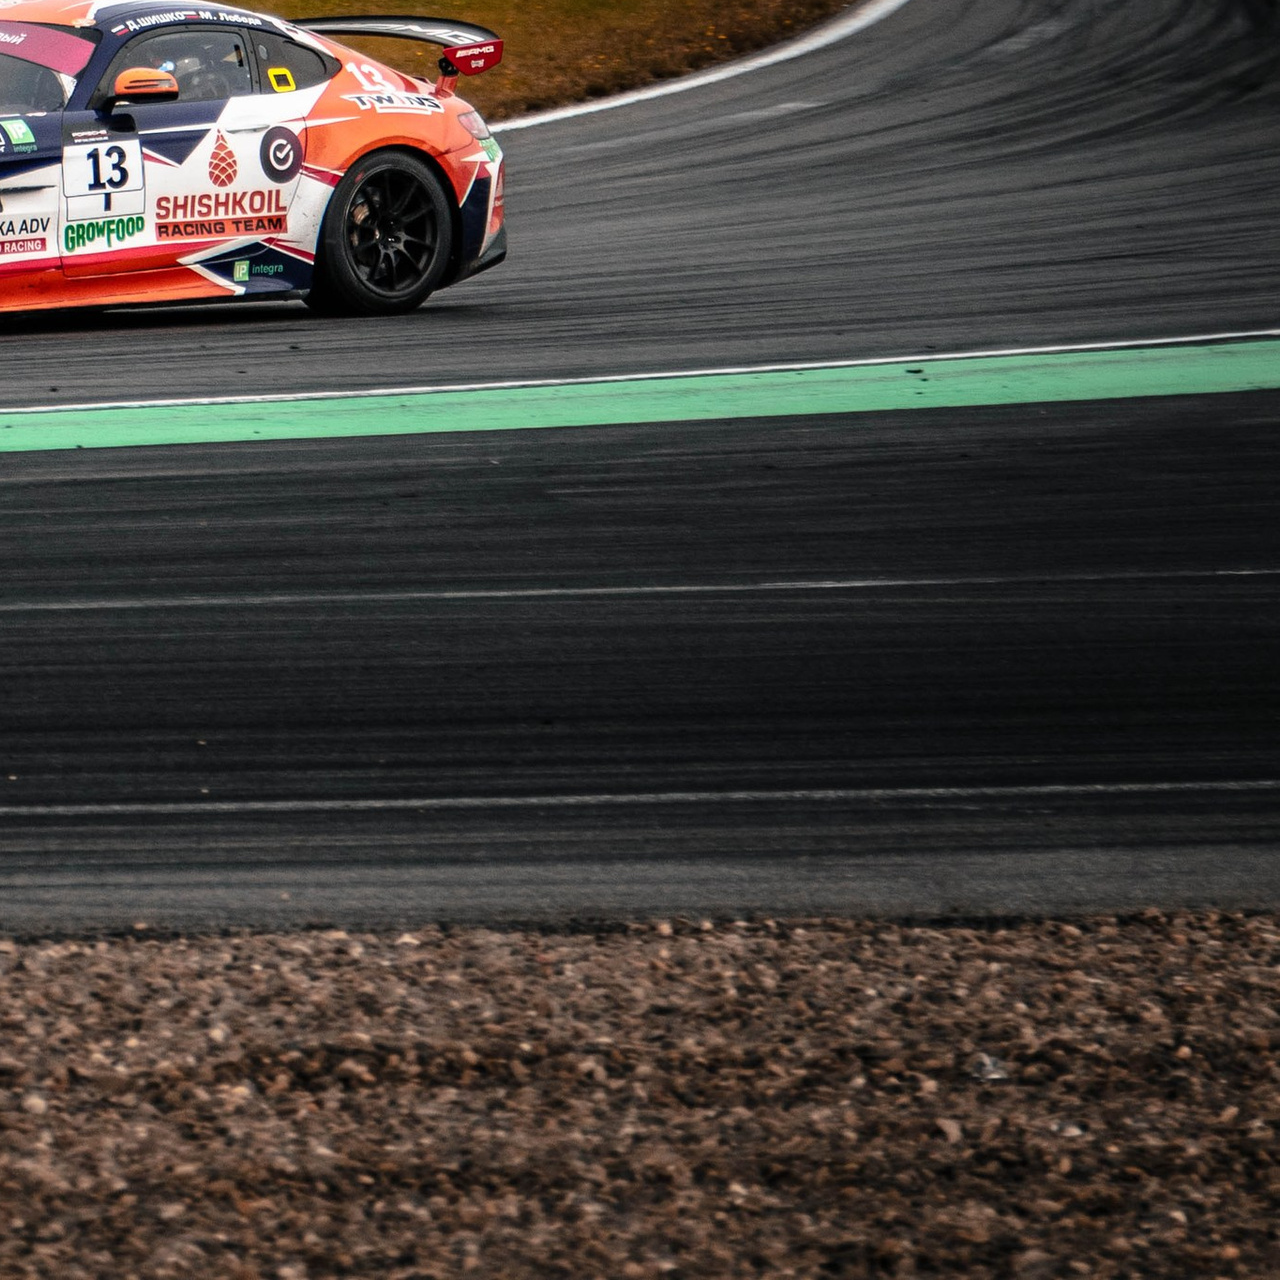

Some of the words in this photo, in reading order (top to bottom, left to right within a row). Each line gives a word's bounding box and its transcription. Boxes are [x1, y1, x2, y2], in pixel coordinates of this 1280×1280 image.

[345, 61, 396, 93] 13
[86, 145, 129, 191] 13
[155, 189, 287, 220] SHISHKOIL
[18, 217, 50, 235] ADV
[158, 222, 225, 237] RACING
[232, 218, 283, 233] TEAM
[4, 240, 42, 253] RACING
[252, 264, 284, 276] integra
